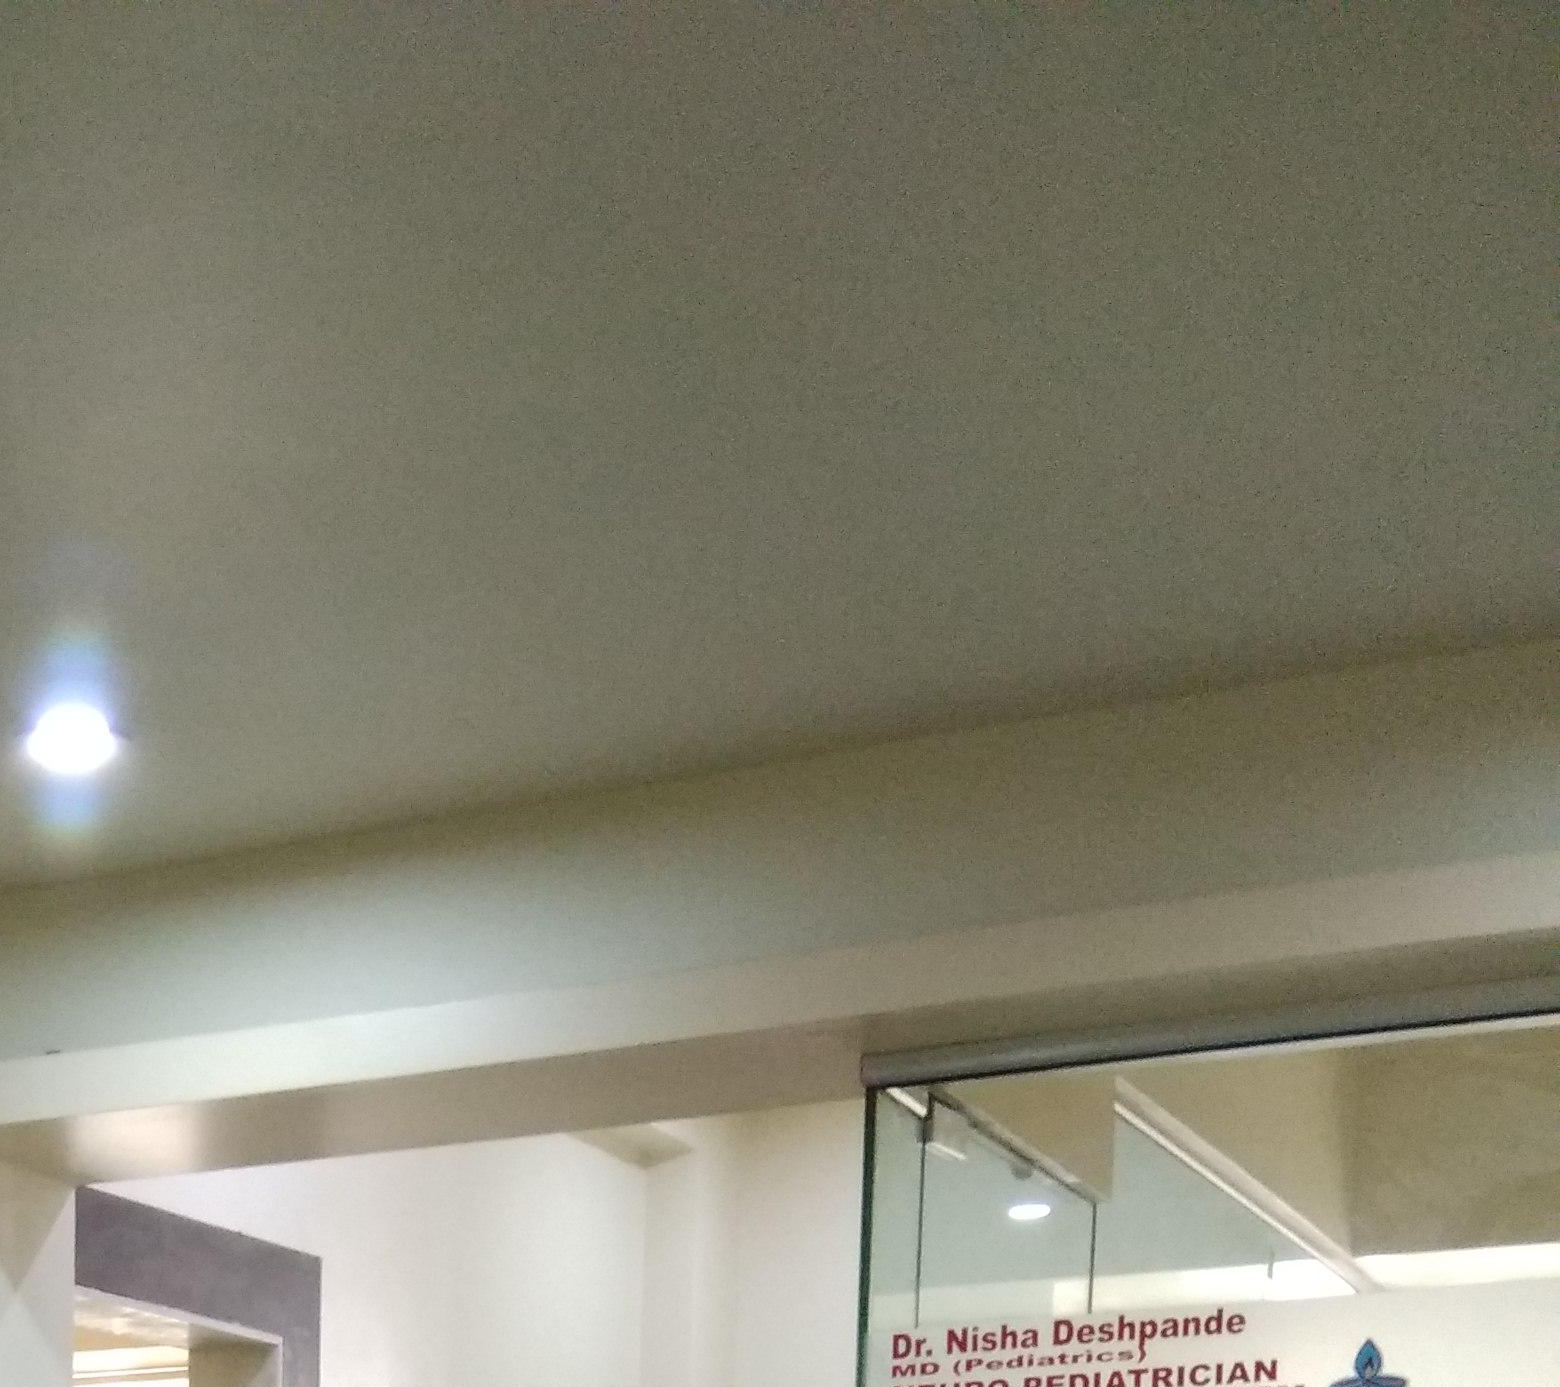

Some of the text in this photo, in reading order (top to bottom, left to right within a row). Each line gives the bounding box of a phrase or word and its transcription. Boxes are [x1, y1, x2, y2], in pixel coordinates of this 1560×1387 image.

[892, 1308, 1246, 1359] Dr. Nisha Deshpande
[892, 1349, 1147, 1378] MD (Pediatrics)
